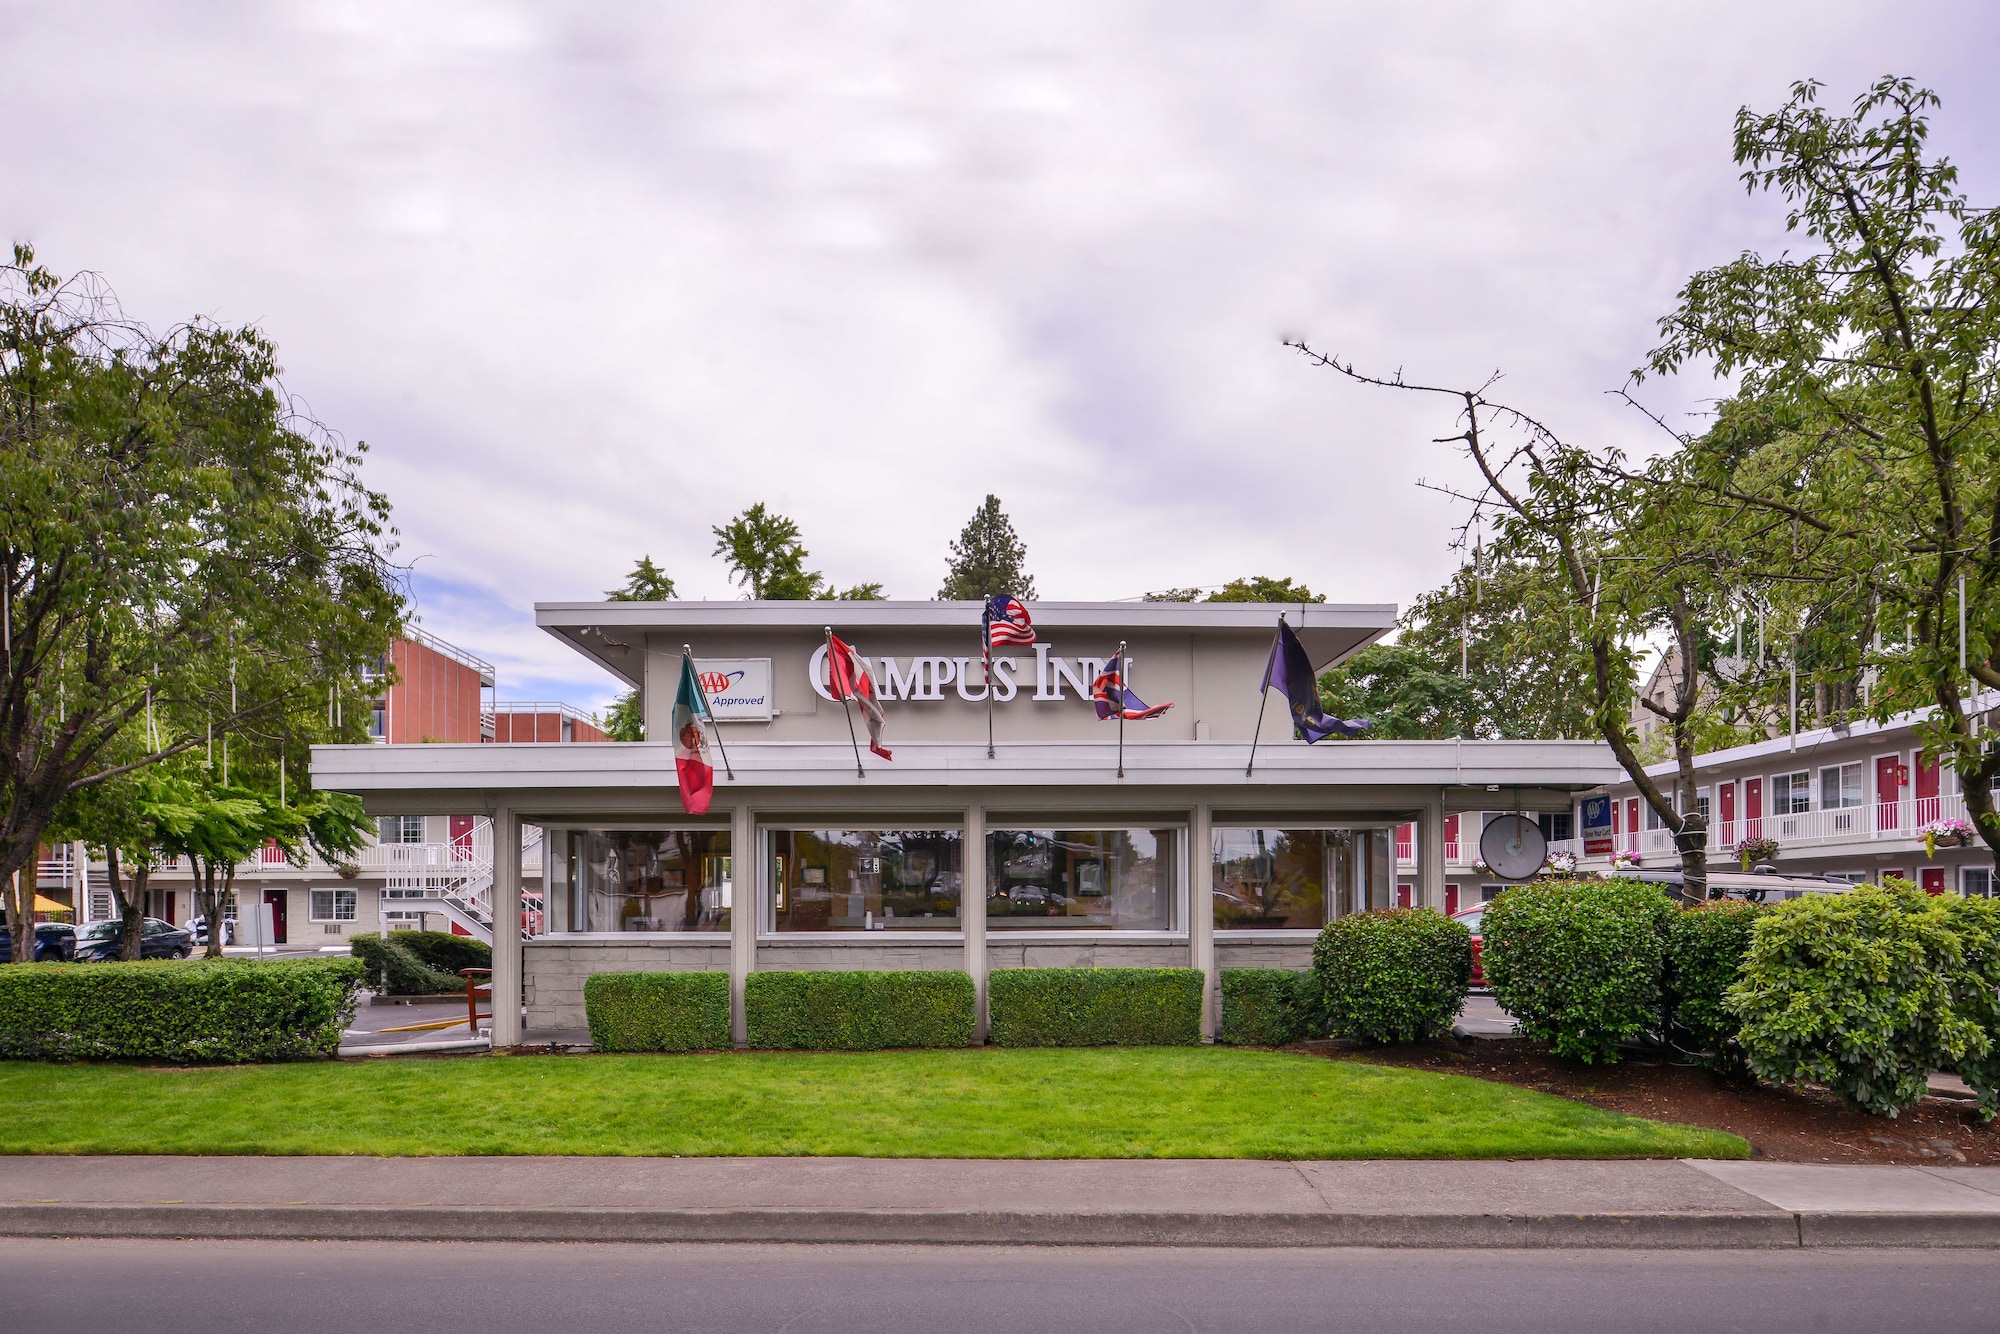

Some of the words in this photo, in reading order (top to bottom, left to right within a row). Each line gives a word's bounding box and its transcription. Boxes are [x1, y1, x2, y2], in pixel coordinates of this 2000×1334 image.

[698, 671, 730, 694] AAA
[712, 695, 765, 707] Approved
[1292, 701, 1316, 726] 189
